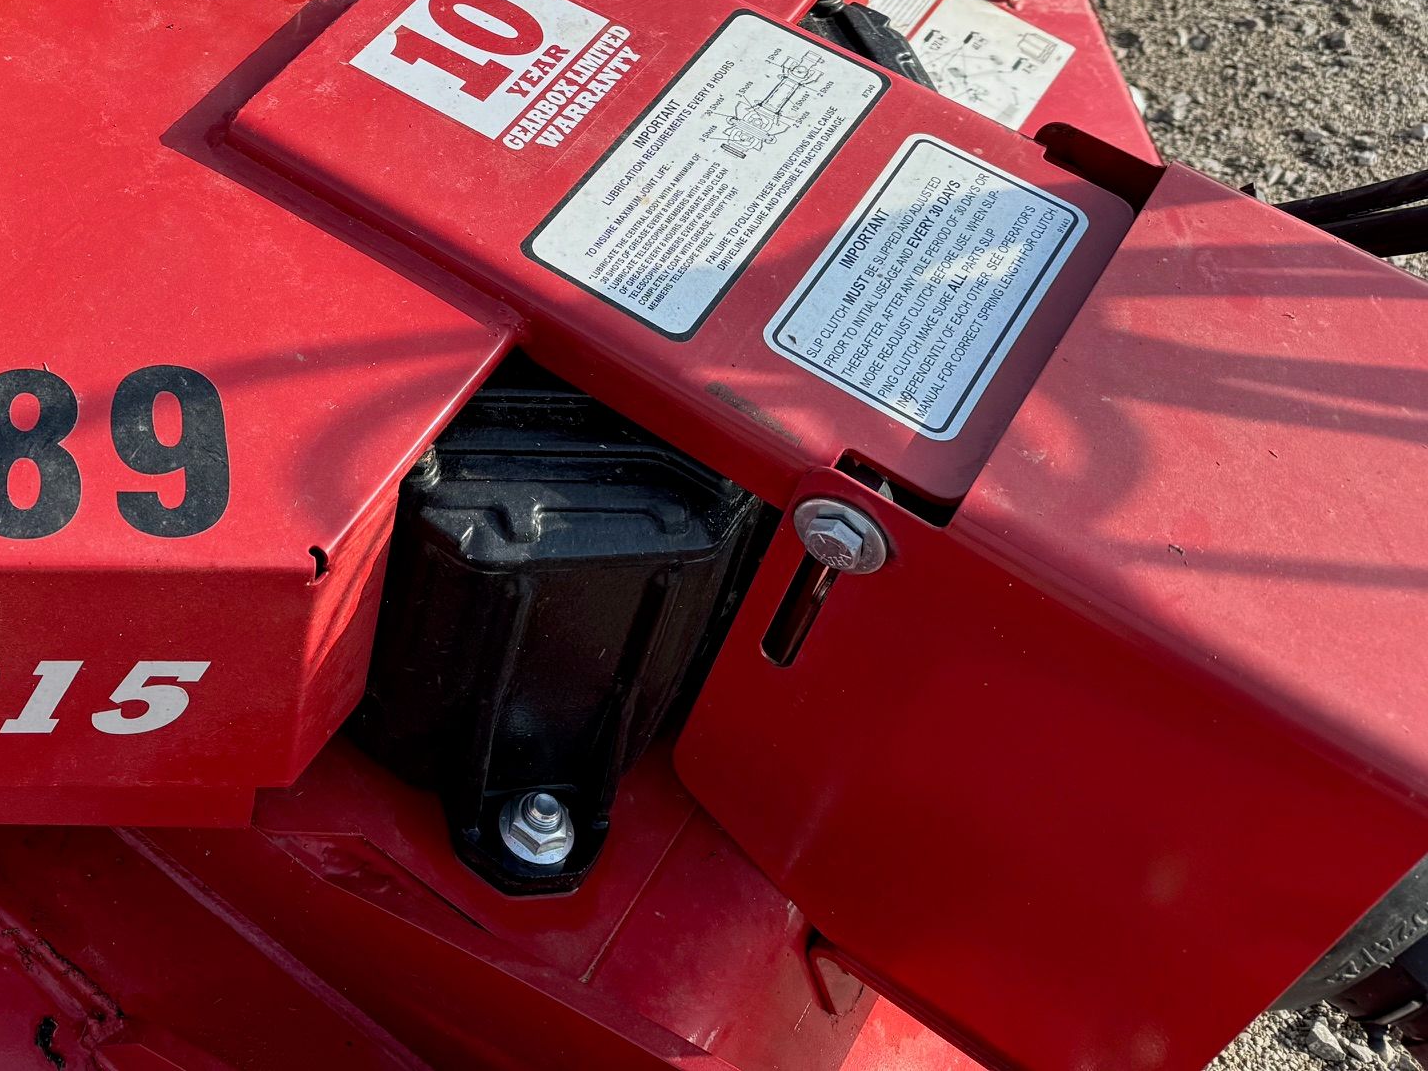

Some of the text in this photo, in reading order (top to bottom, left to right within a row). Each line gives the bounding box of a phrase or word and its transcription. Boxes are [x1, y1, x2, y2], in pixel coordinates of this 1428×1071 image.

[502, 25, 631, 151] GEARBOX LIMITED
[505, 44, 571, 98] YEAR
[535, 45, 642, 148] WARRANTY
[601, 159, 647, 206] LUBRICATION
[641, 108, 692, 160] REQUIREMENTS
[686, 86, 711, 110] EVERY
[709, 59, 735, 83] HOURS
[631, 98, 682, 148] IMPORTANT
[584, 162, 672, 258] TO INSURE MAXIMUM JOINT LIFE:
[633, 222, 668, 260] TELESCOPING
[663, 197, 690, 224] MEMBERS
[685, 184, 701, 199] WITH
[702, 161, 721, 179] SHOTS
[704, 105, 837, 265] FAILURE TO FOLLOW THESE INSTRUCTIONS WILL CAUSE
[716, 113, 846, 271] DRIVELINE FAILURE AND POSSIBLE TRACTOR DAMAGE.
[944, 214, 960, 228] OF
[953, 204, 967, 216] 30
[959, 184, 981, 206] DAYS
[973, 172, 989, 186] OR
[804, 175, 942, 358] SLIP CLUTCH MUST BE SLIPPED AND ADJUSTED
[822, 179, 961, 368] PRIOR TO INITIAL USEAGE AND EVERY 30 DAYS
[837, 207, 891, 269] IMPORTANT
[911, 255, 932, 277] IDLE
[924, 225, 952, 257] PERIOD
[858, 360, 884, 388] MORE
[876, 315, 915, 362] READJUST
[906, 282, 937, 318] CLUTCH
[929, 250, 959, 284] BEFORE
[964, 206, 989, 233] WHEN
[876, 227, 997, 399] PING CLUTCH MAKE SURE ALL PARTS SLIP
[879, 291, 907, 322] AFTER
[898, 274, 919, 294] ANY
[912, 379, 945, 419] MANUAL
[936, 360, 958, 383] FOR
[949, 319, 985, 363] CORRECT
[976, 287, 1005, 321] SPRING
[997, 254, 1026, 289] LENGTH
[1018, 237, 1037, 256] FOR
[940, 323, 957, 339] OF
[949, 299, 973, 325] EACH
[985, 252, 1004, 271] SEE
